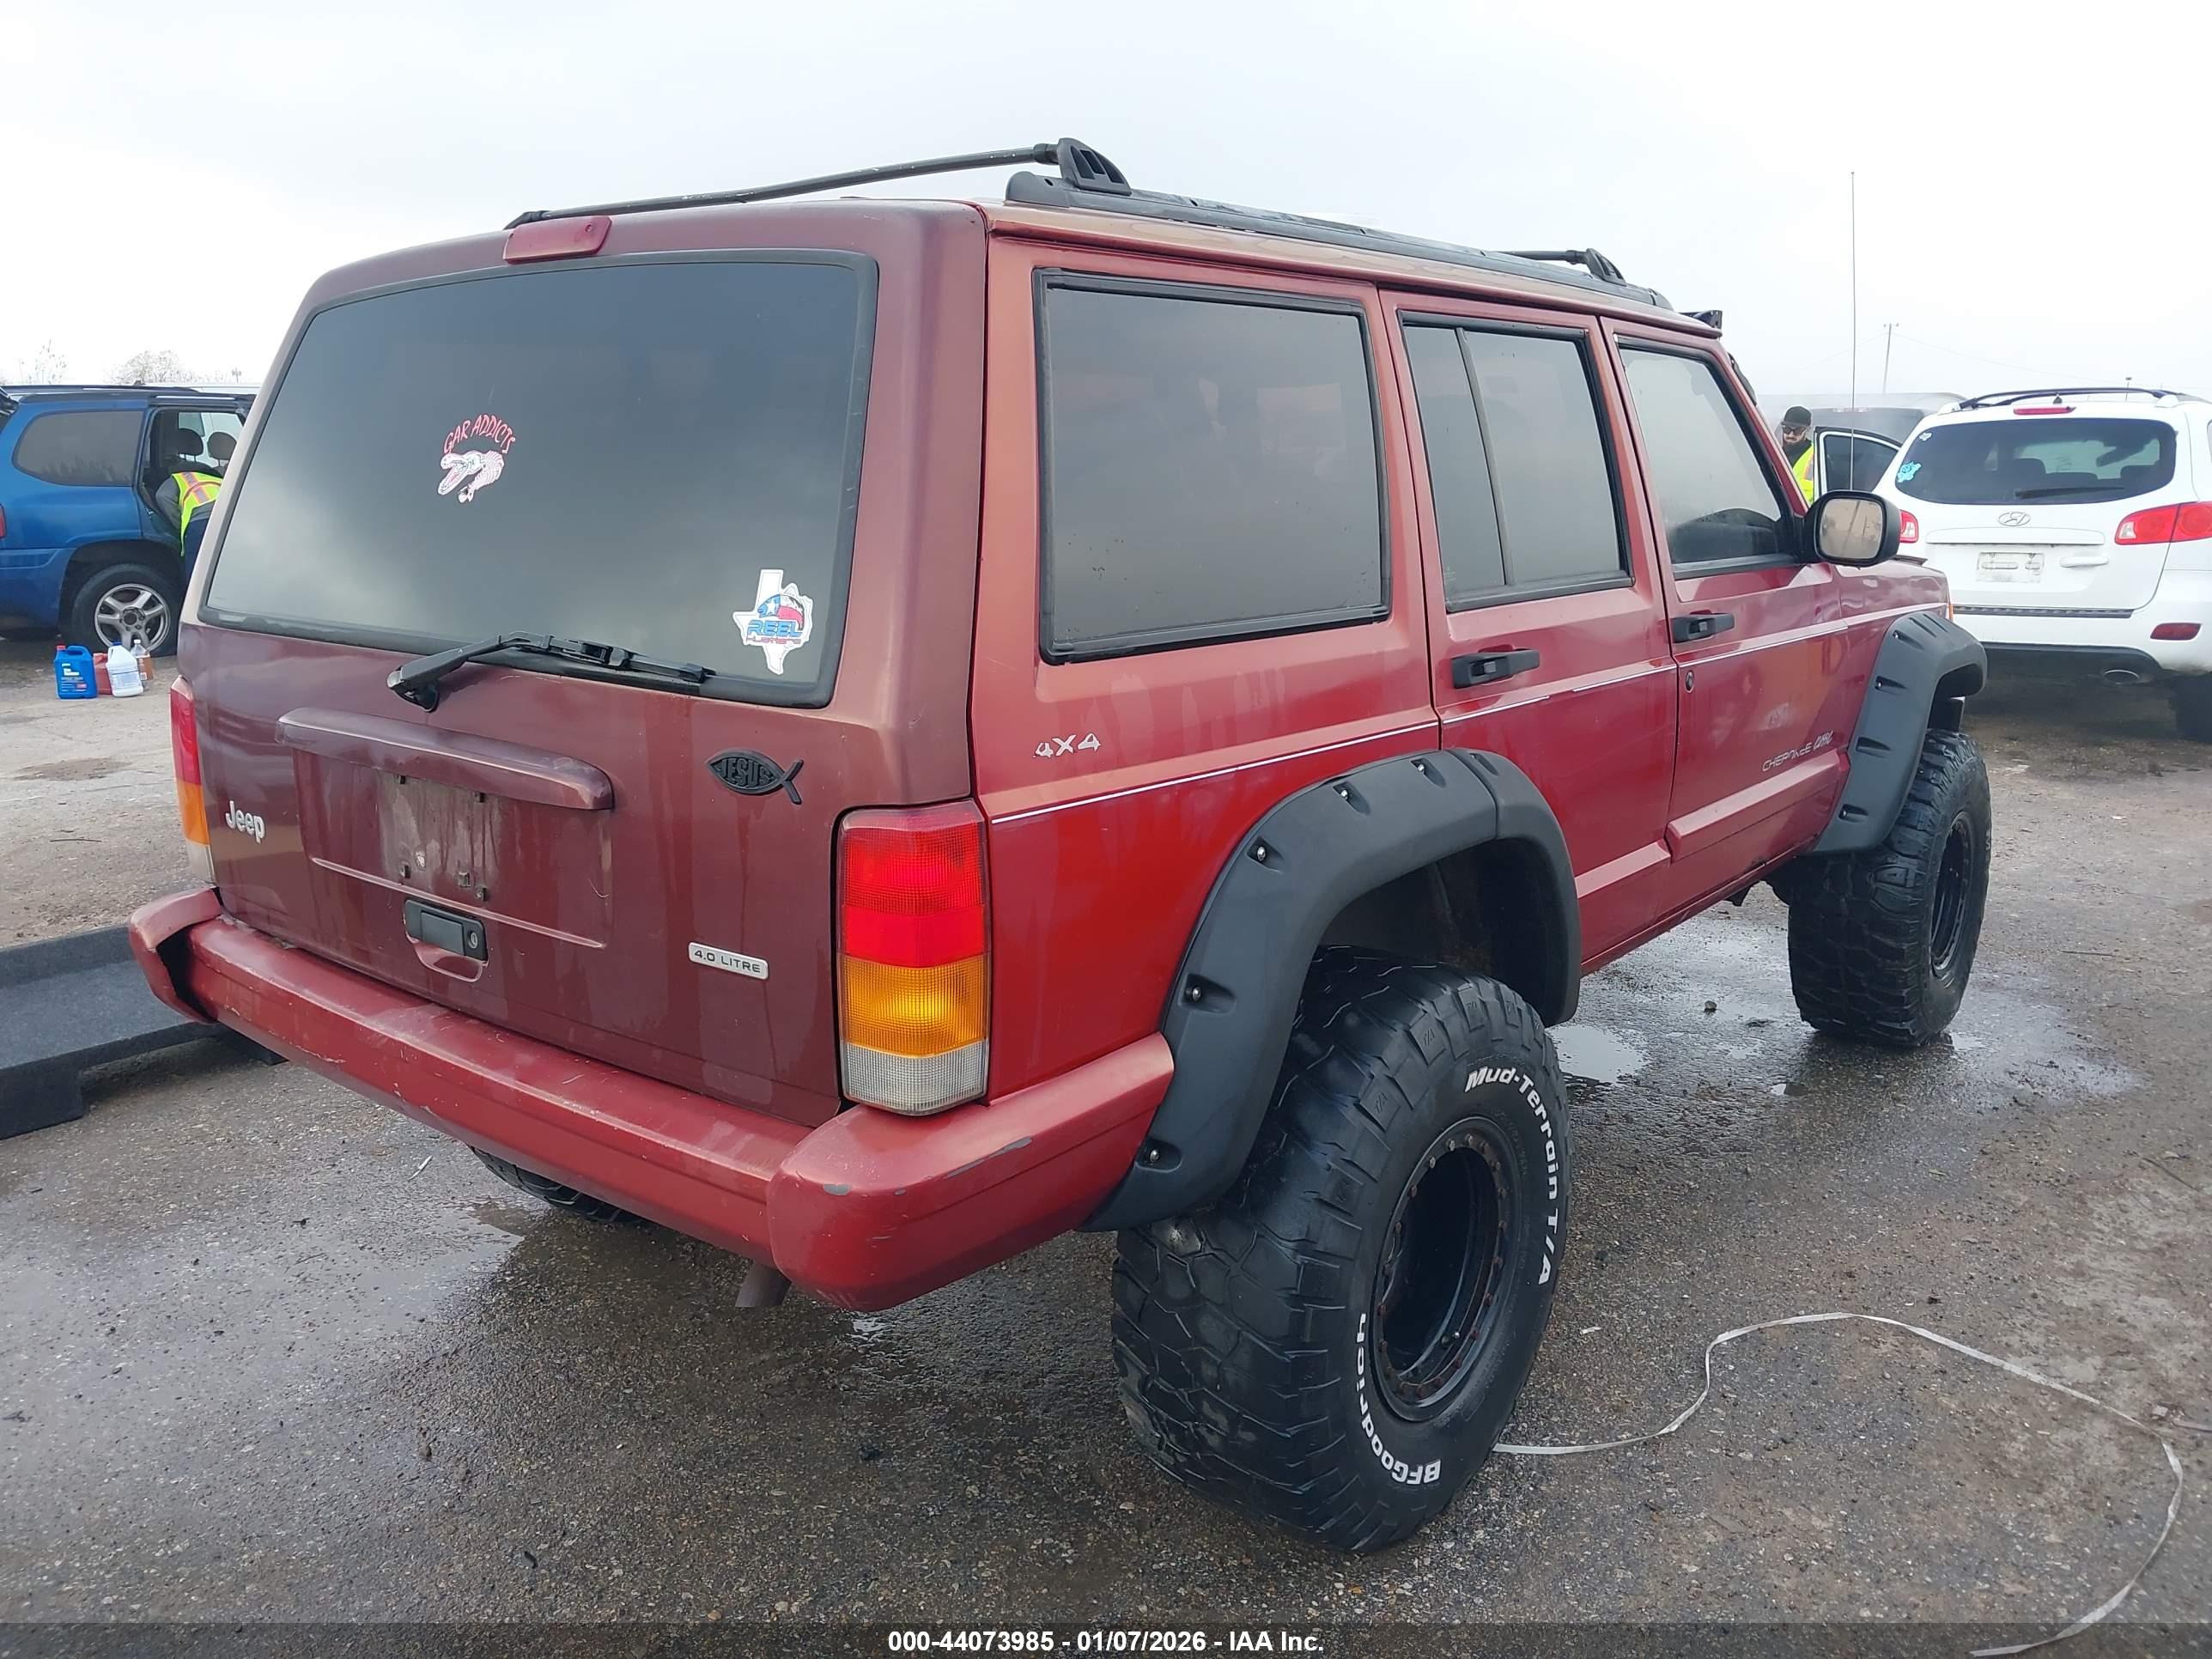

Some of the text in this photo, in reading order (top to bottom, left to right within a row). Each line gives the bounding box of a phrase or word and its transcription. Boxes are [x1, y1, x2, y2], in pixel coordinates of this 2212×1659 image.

[444, 414, 516, 454] GAR ADDICTS
[747, 619, 803, 637] REEL
[714, 757, 772, 788] JESUS
[225, 800, 265, 845] Jeep
[695, 949, 762, 974] 4.0 LITRE
[1465, 1066, 1559, 1200] Mud-Terrain
[1538, 1207, 1559, 1285] T/A
[1356, 1313, 1442, 1485] BFGoodrich
